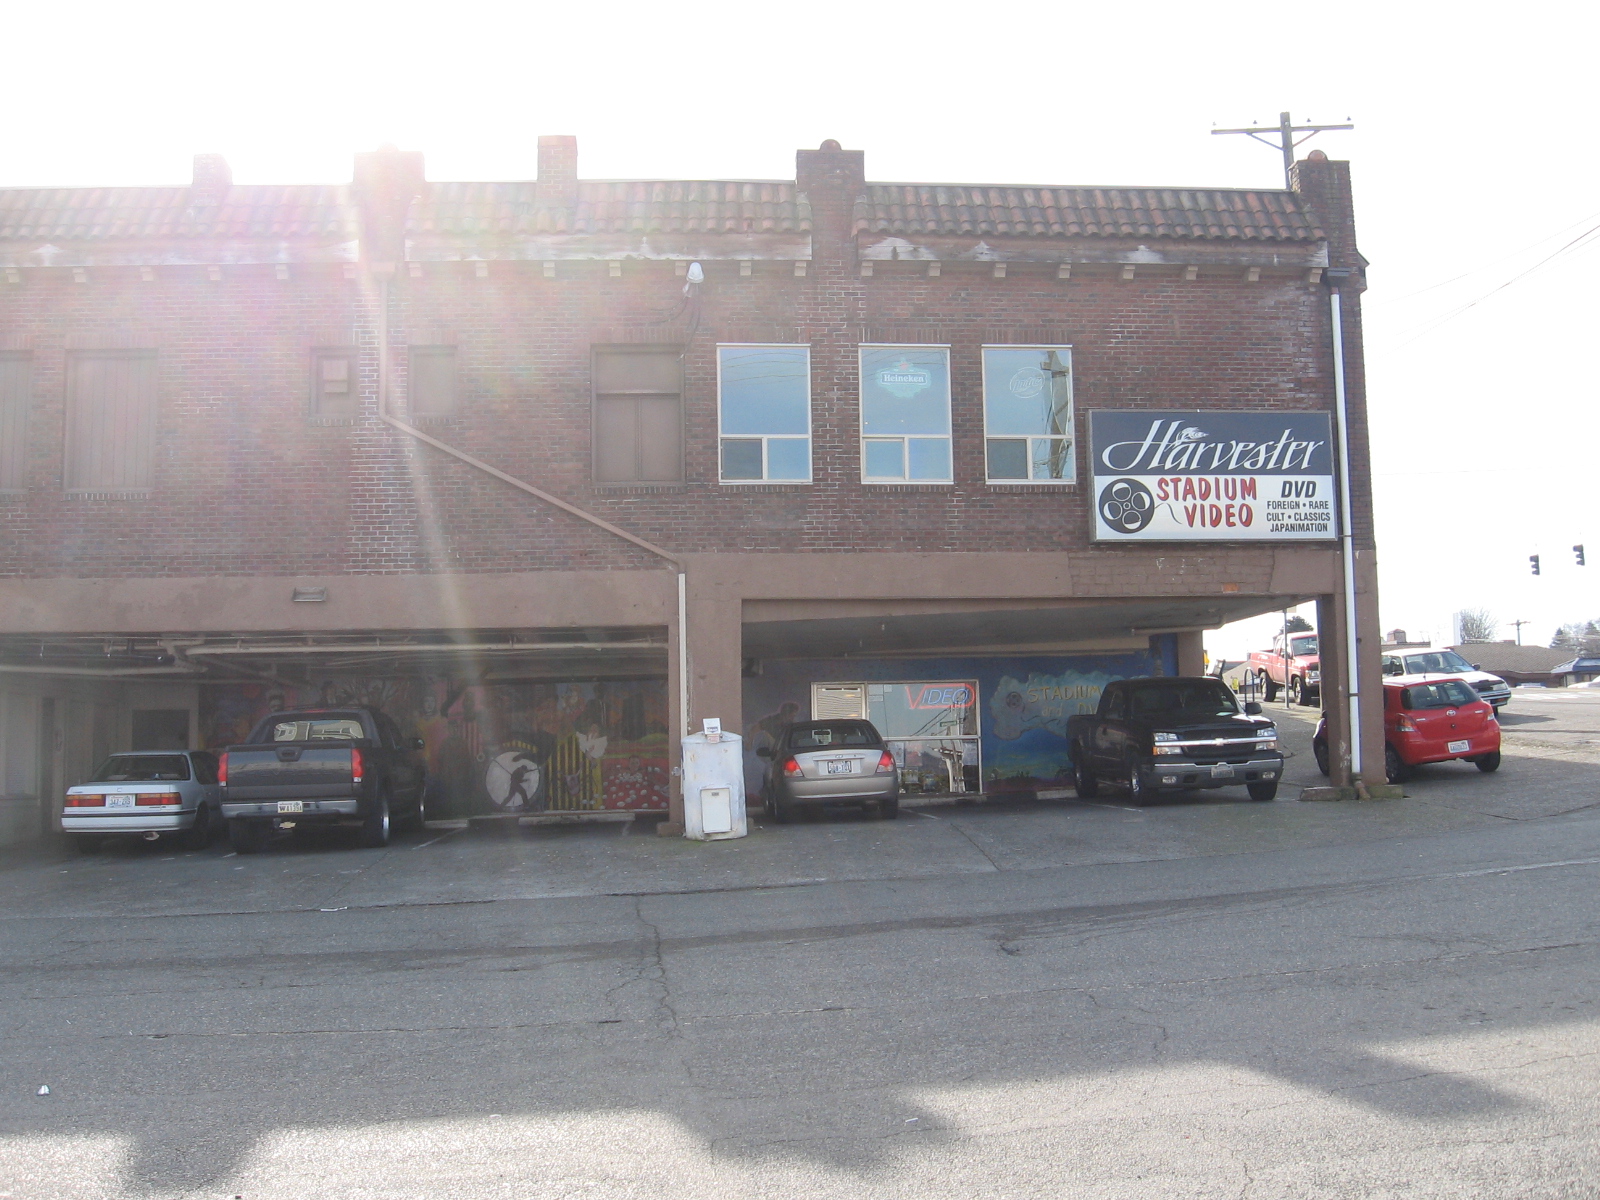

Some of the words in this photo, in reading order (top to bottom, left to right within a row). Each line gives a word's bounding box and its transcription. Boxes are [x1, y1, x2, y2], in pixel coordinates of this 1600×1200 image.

[883, 374, 924, 382] Heineken
[1102, 419, 1325, 471] Harvester
[1156, 477, 1257, 502] STADIUM
[1280, 480, 1317, 498] DVD
[1267, 501, 1300, 510] FOREIGN
[1308, 500, 1329, 510] RARE
[1184, 503, 1253, 528] VIDEO
[1266, 512, 1285, 521] CULT
[1294, 512, 1331, 521] CLASSICS
[1270, 522, 1328, 532] JAPANIMATION
[904, 684, 970, 709] VIDEO
[1027, 685, 1101, 703] STADIUM
[1041, 703, 1062, 717] and
[1078, 702, 1099, 715] DV
